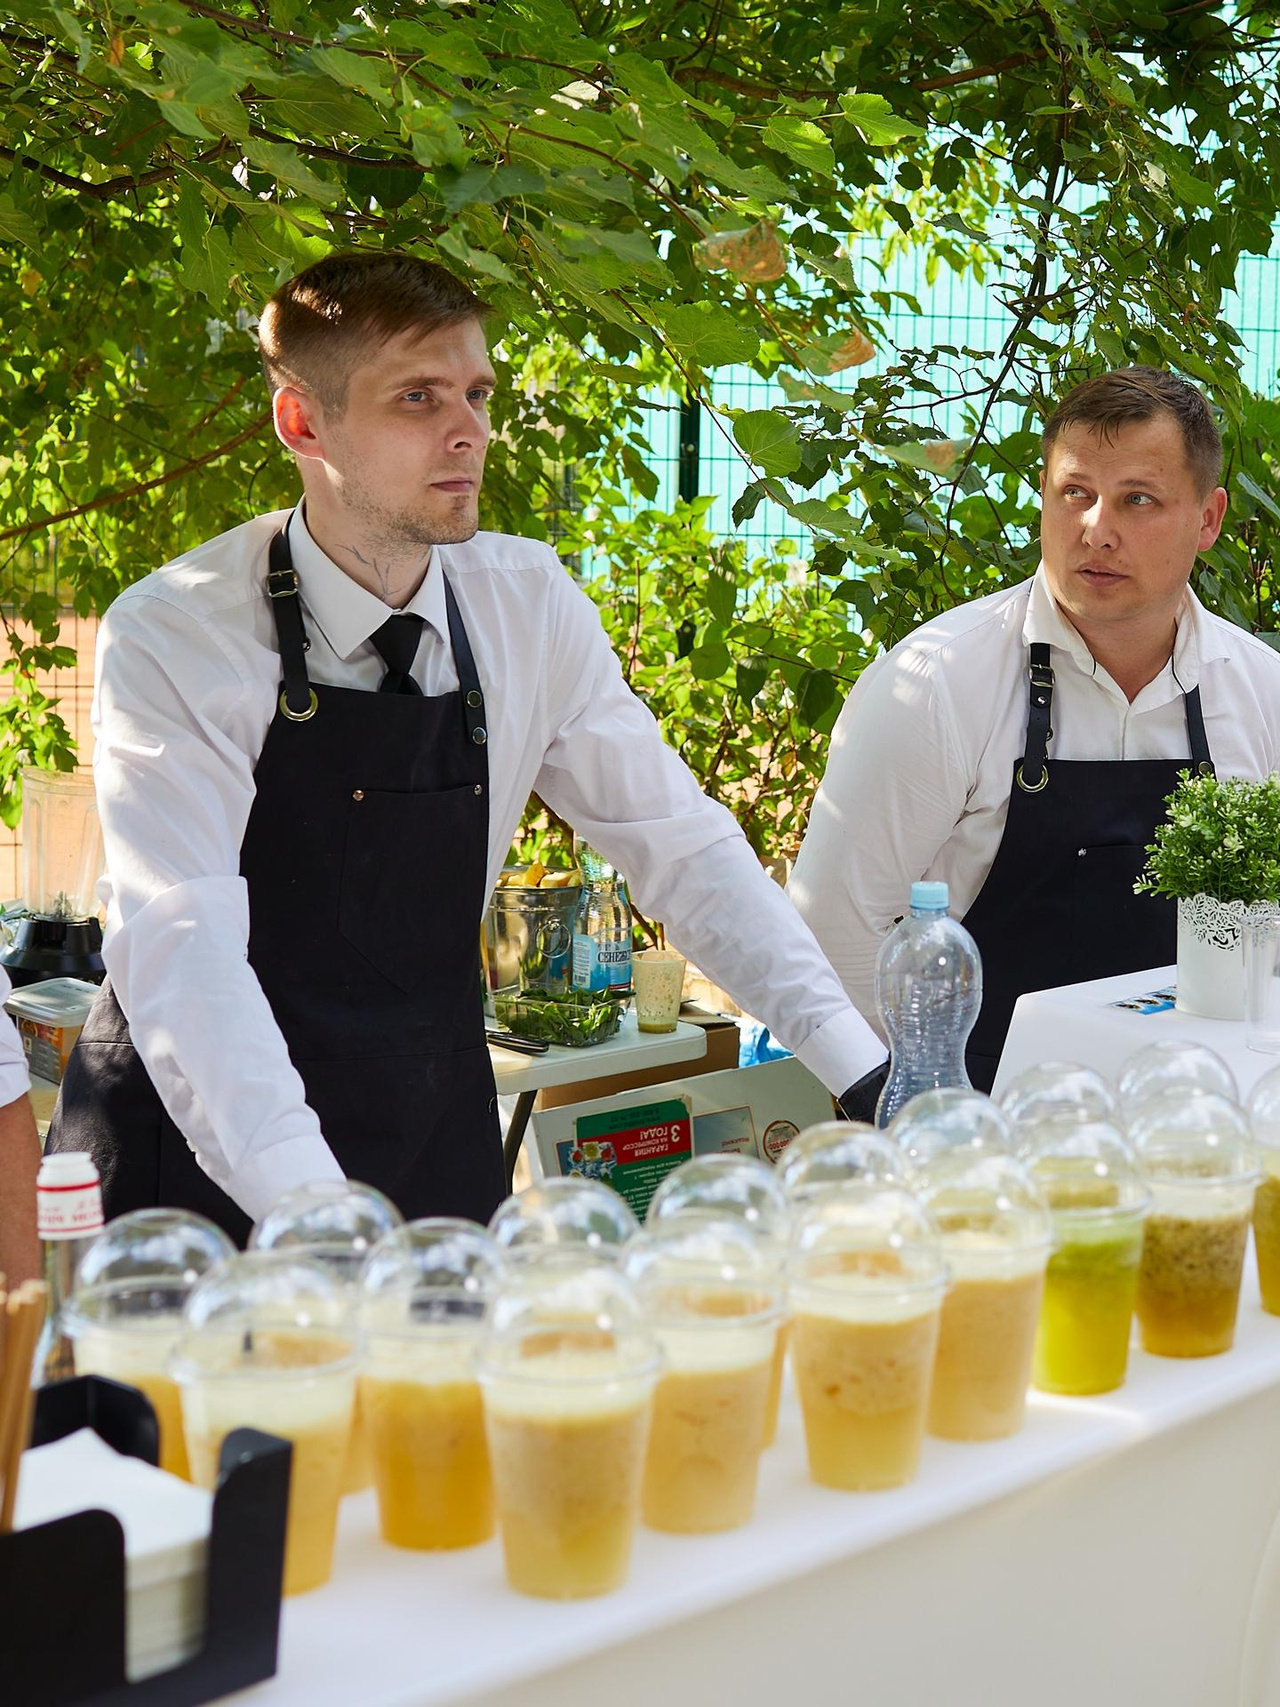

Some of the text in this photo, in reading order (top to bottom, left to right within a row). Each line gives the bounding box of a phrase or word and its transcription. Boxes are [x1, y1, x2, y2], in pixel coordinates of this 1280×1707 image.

[640, 1124, 681, 1143] 3 ГОДА!
[634, 1143, 669, 1157] ГАРАНТИЯ
